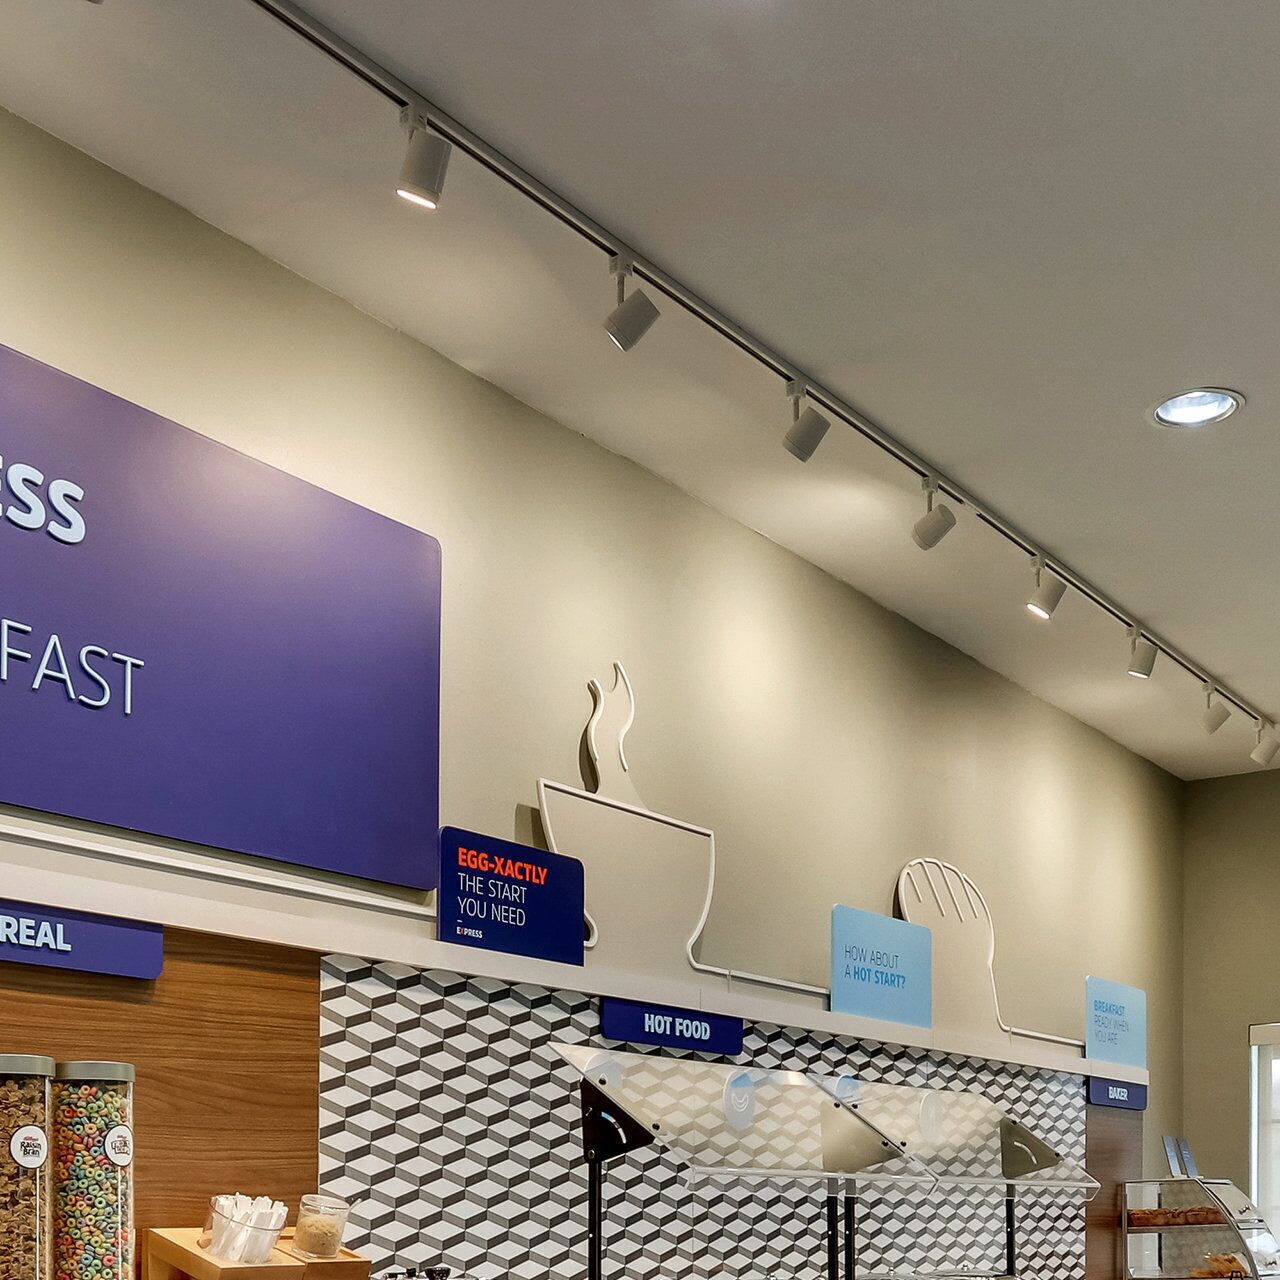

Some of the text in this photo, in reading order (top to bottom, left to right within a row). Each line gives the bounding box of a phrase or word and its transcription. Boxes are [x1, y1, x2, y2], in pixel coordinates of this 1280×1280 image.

[457, 846, 549, 886] EGG-XACTLY
[457, 872, 528, 905] THE START
[457, 895, 526, 927] YOU NEED
[456, 925, 483, 939] EXPRESS
[844, 944, 900, 971] HOW ABOUT
[844, 964, 906, 990] A HOT START?
[1094, 999, 1126, 1017] BREAKFAST
[644, 1013, 711, 1041] HOT FOOD
